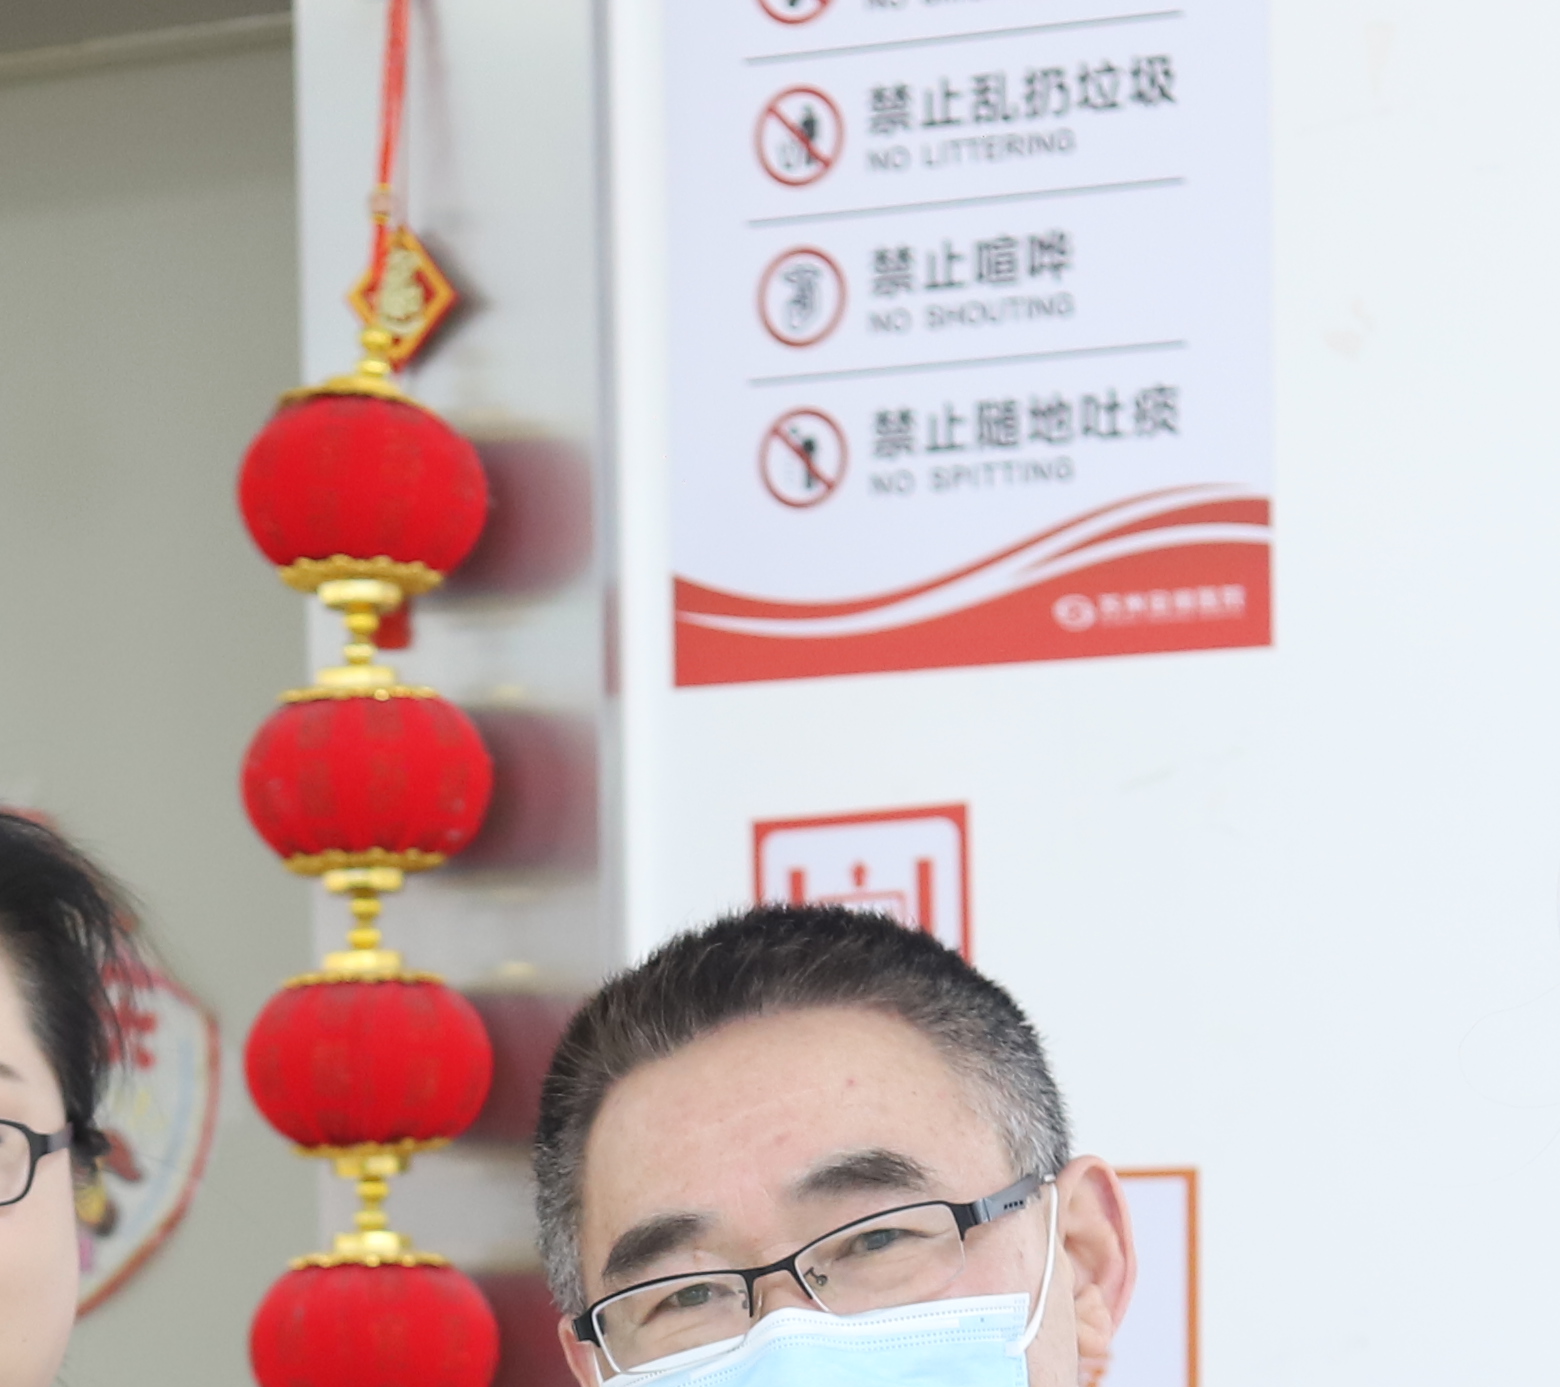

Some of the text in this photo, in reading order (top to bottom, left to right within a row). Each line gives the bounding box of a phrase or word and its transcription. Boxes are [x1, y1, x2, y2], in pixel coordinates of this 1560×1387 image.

[868, 54, 1178, 134] 禁止乱扔垃圾
[867, 127, 1077, 172] NO LITTERING
[870, 229, 1074, 298] 禁止喧哗
[867, 292, 1076, 334] NO SHOUTING
[870, 383, 1180, 459] 禁止随地吐痰
[869, 456, 1075, 496] NO SPITTING
